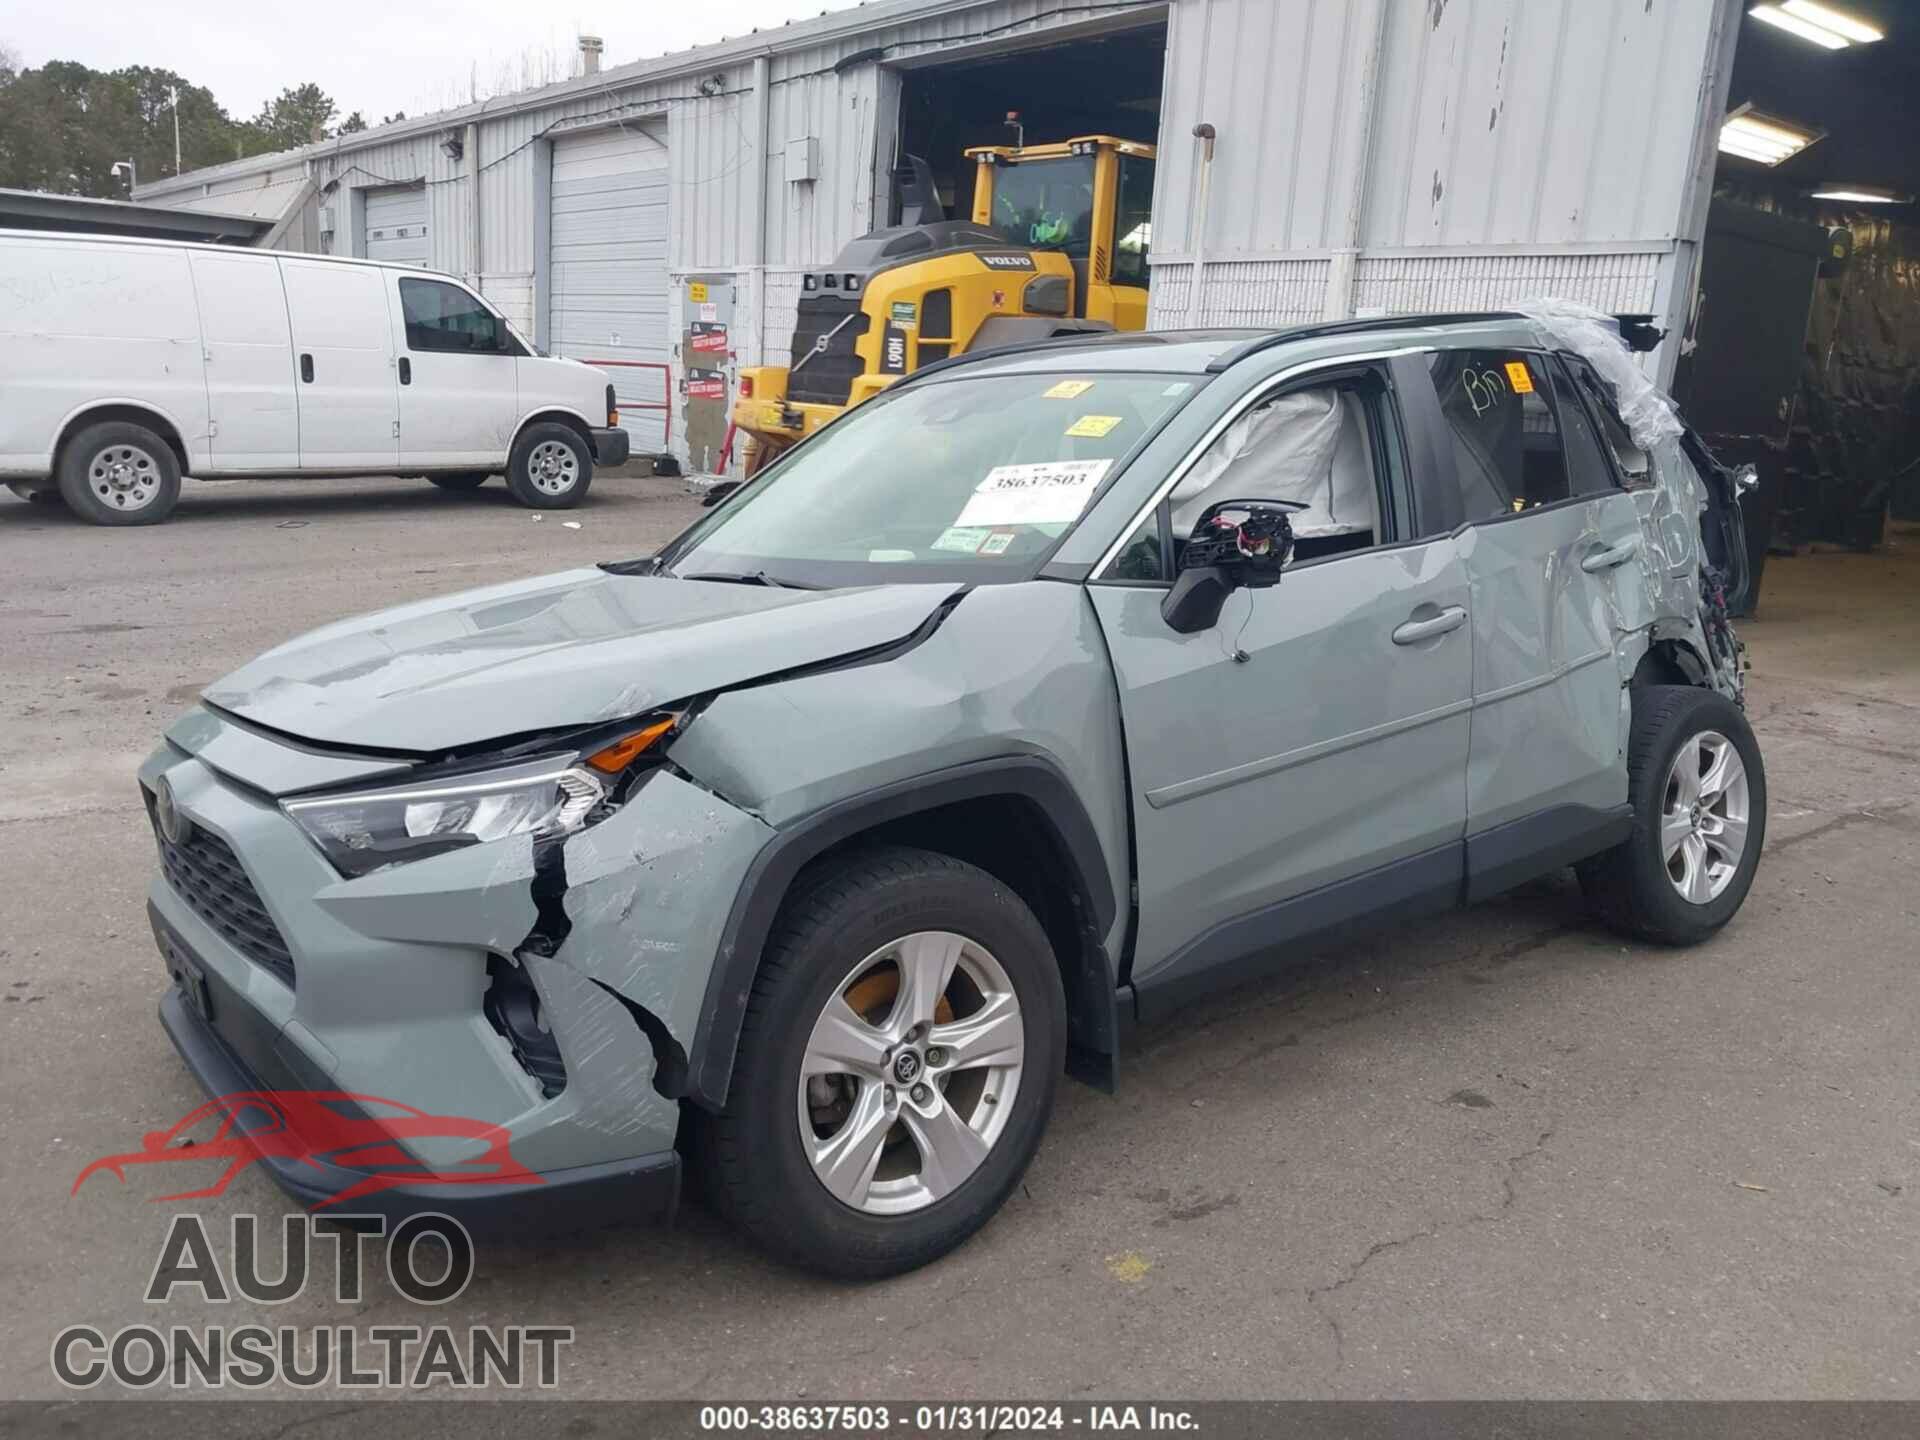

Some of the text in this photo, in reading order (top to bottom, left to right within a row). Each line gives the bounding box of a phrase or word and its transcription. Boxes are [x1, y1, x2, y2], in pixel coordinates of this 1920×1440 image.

[983, 256, 1031, 266] VOLVO
[888, 337, 904, 368] L90H
[990, 473, 1087, 490] 38637503
